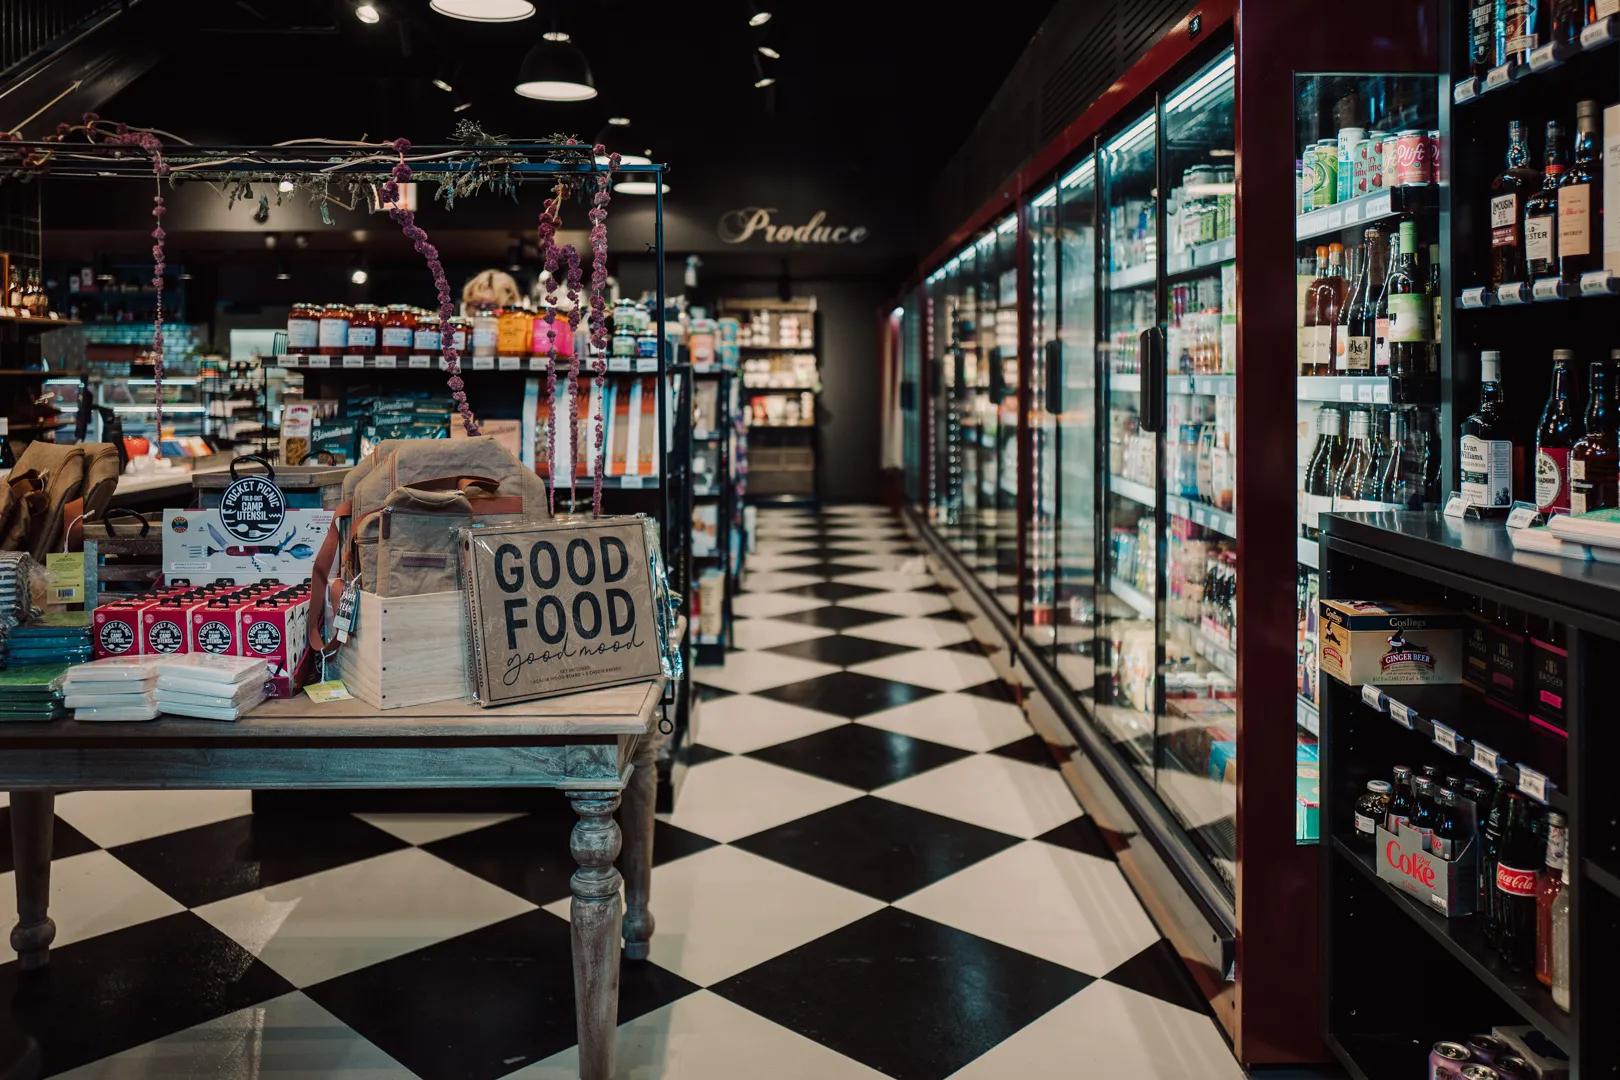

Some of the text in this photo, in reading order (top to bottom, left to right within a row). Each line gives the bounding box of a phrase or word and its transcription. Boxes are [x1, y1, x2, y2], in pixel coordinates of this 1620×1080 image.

[716, 206, 870, 244] Produce
[1463, 442, 1477, 452] Evan
[225, 481, 280, 508] POCKET PICNIC
[236, 510, 268, 521] UTENSIL
[241, 501, 264, 511] CAMP
[494, 536, 629, 594] GOOD
[504, 588, 636, 650] FOOD
[1389, 617, 1427, 628] Goslings
[502, 623, 645, 686] good mood
[1385, 653, 1430, 664] GINGER BEER
[1538, 670, 1563, 688] BADGER
[1386, 840, 1435, 889] Coke
